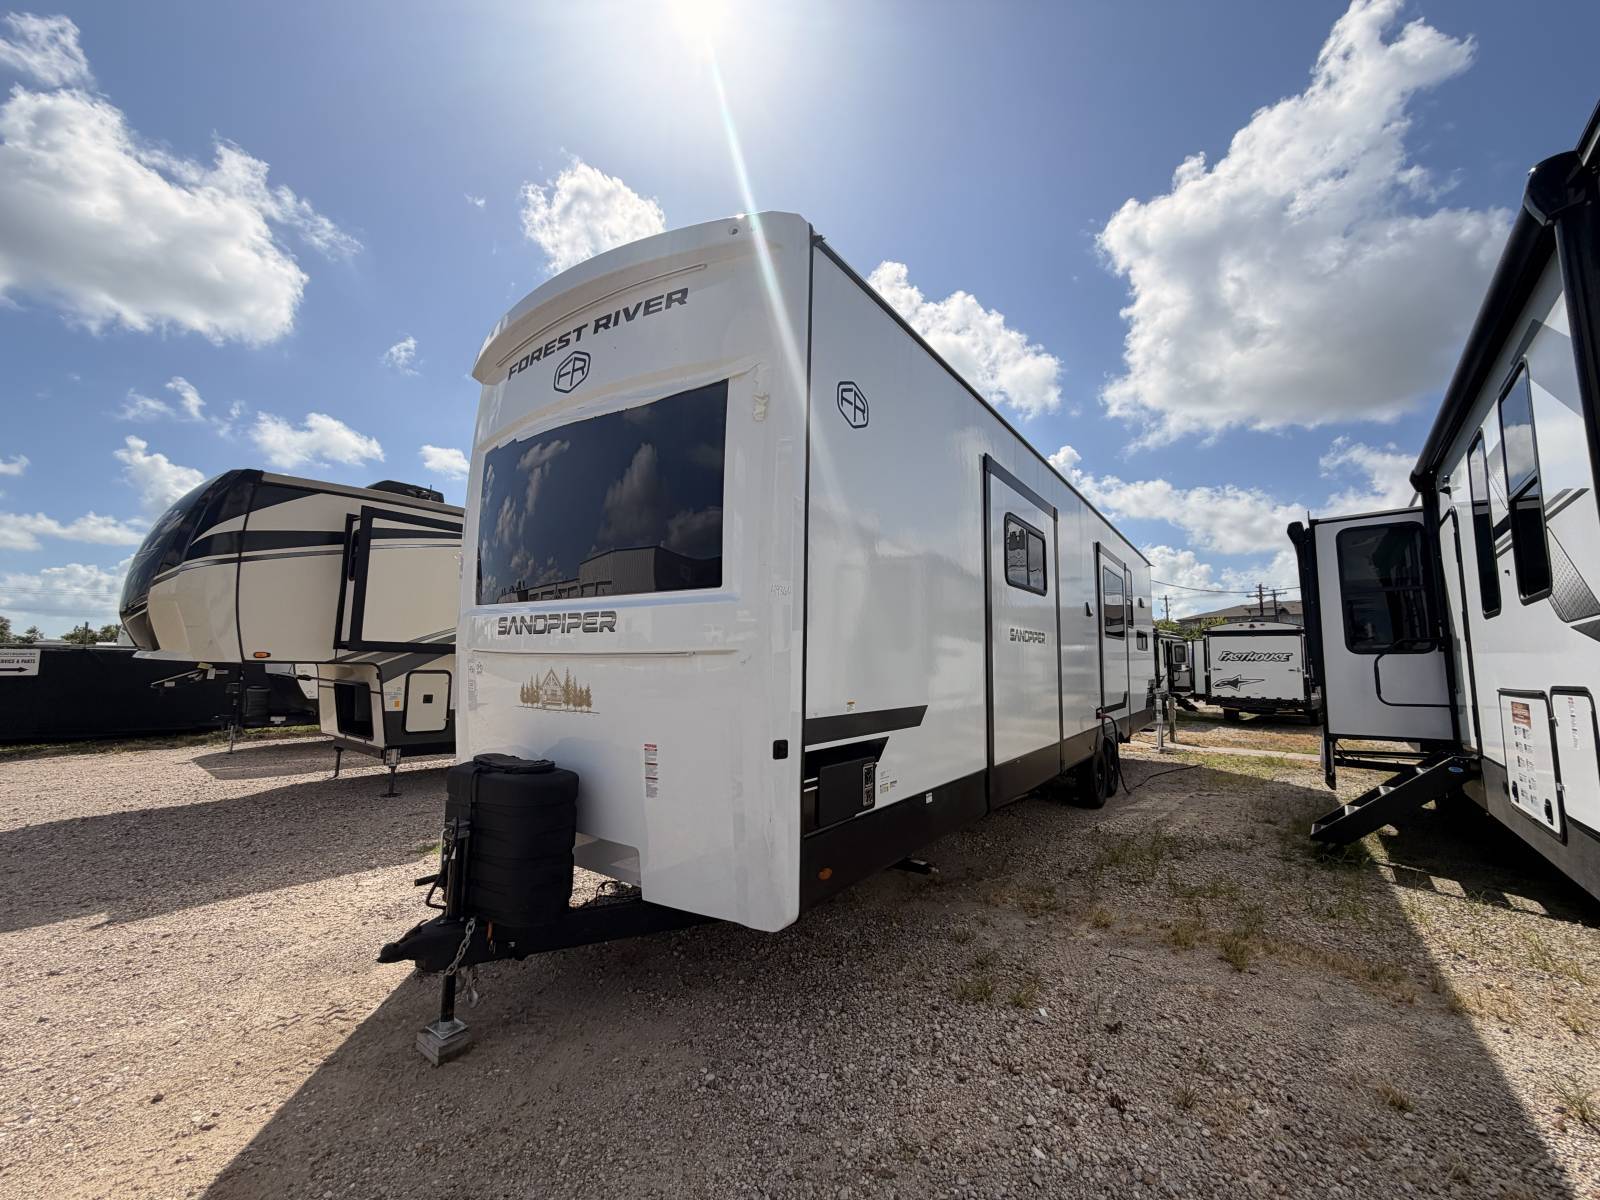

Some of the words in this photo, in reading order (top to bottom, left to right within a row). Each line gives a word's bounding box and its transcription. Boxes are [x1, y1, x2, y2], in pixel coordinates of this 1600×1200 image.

[508, 323, 589, 381] FOREST
[593, 287, 689, 335] RIVER
[497, 610, 617, 635] SANDPIPER
[1009, 628, 1046, 643] SANDPIPER
